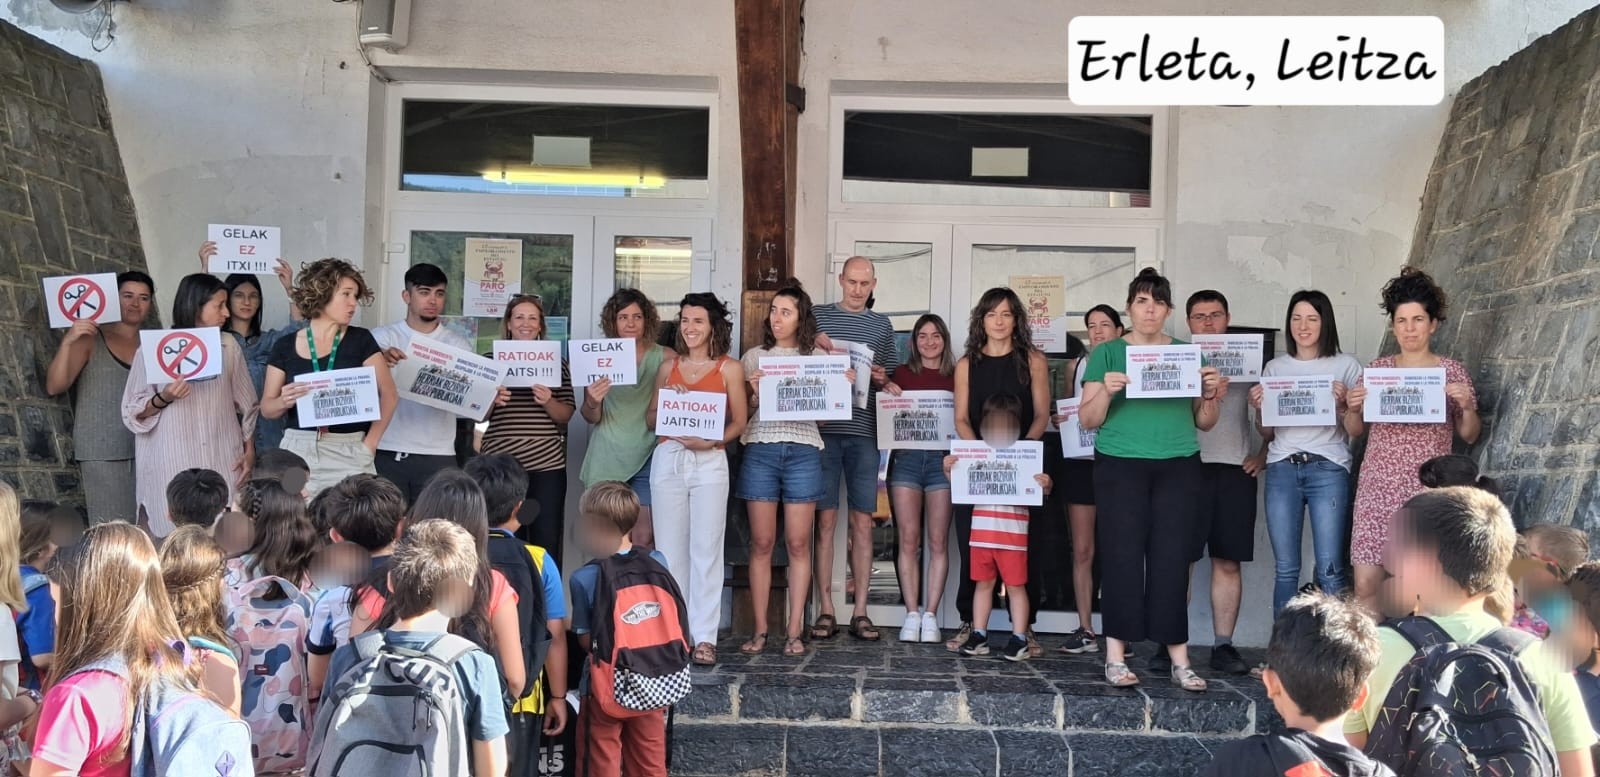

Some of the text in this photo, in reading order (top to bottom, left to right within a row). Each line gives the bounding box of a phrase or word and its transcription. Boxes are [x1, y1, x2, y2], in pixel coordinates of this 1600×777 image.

[223, 228, 268, 240] GELAK
[239, 245, 256, 255] EZ
[227, 260, 267, 272] ITXI !!!
[480, 282, 505, 290] PARO
[1030, 317, 1050, 325] ARO
[581, 342, 624, 352] GELAK
[498, 351, 554, 361] RATIOAK
[597, 358, 613, 368] EZ
[506, 367, 553, 377] AITSI !!!
[612, 373, 624, 383] !!!
[778, 387, 801, 400] HERRIAK
[663, 400, 717, 413] RATIOAK
[795, 399, 827, 412] PUBLIKOAN
[662, 416, 716, 430] JAITSI !!!
[969, 471, 993, 482] HERRIAK
